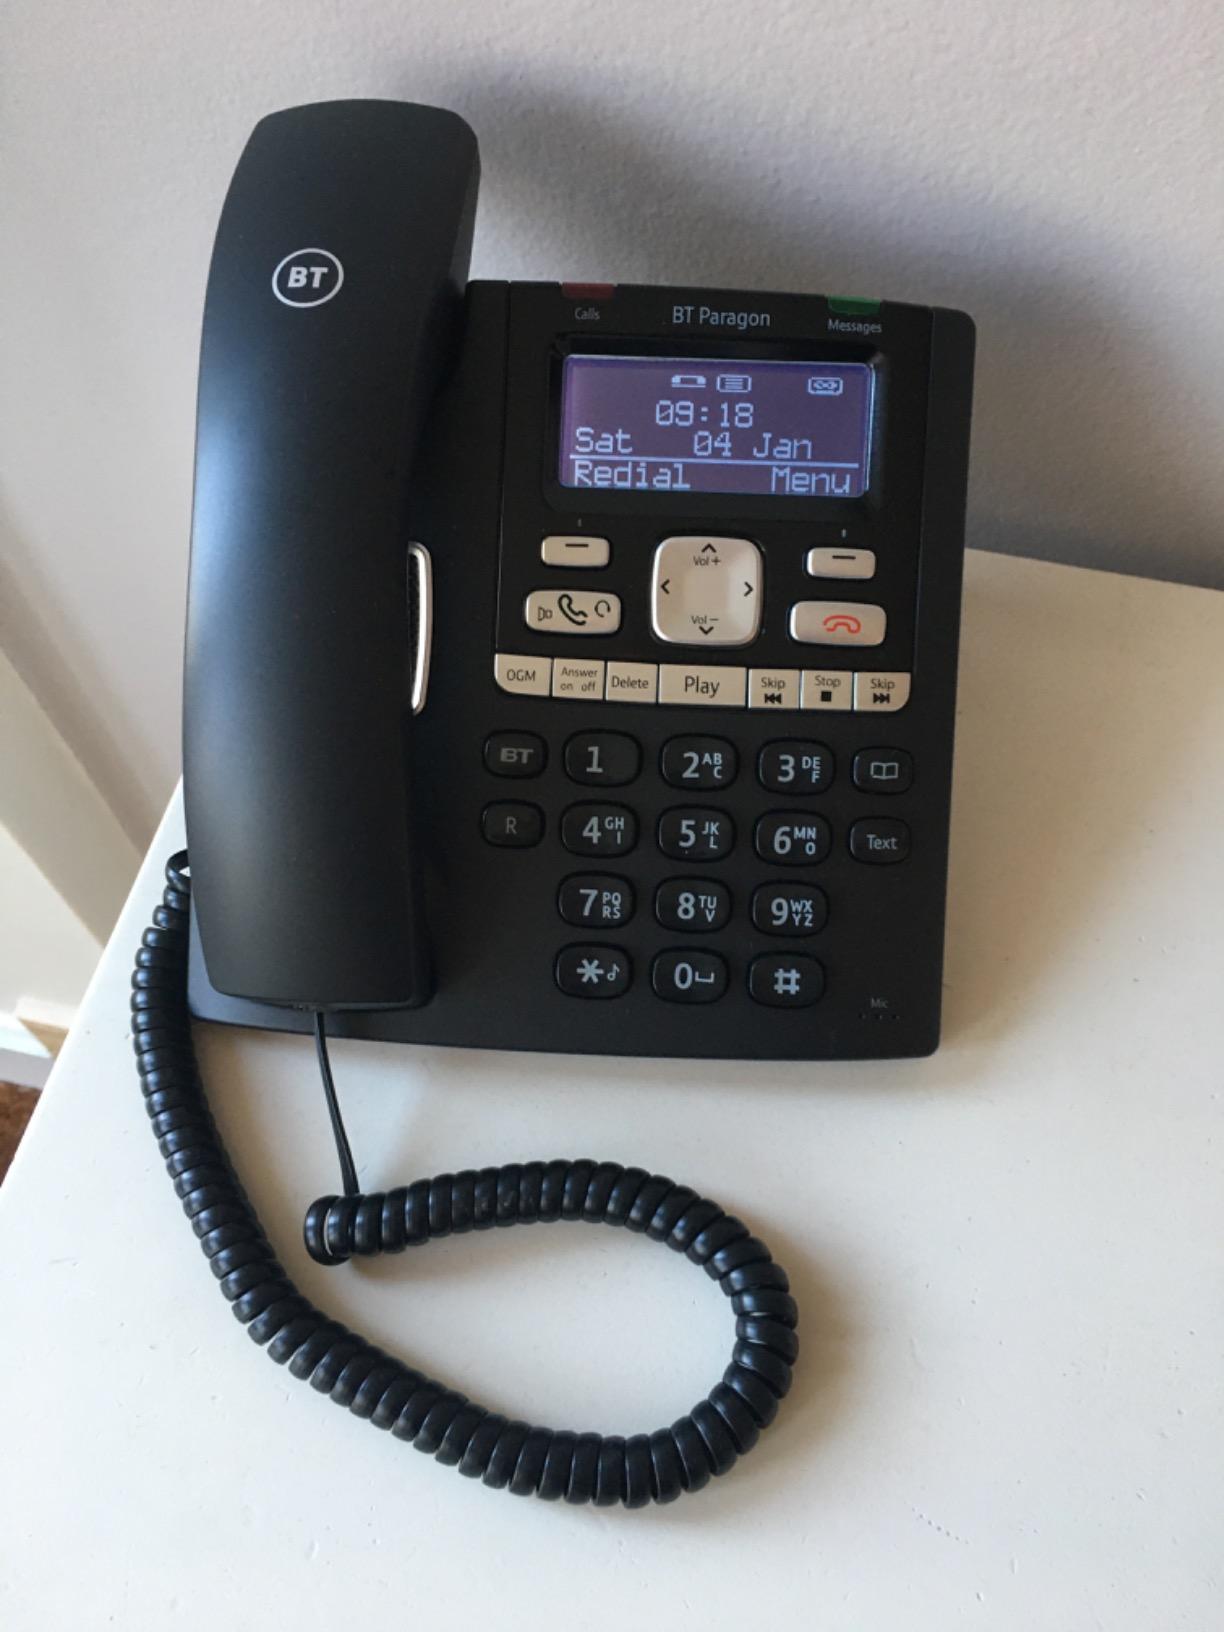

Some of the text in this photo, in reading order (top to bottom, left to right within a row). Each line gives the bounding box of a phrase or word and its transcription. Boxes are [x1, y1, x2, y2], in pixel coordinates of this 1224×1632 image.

[288, 266, 328, 288] BT
[574, 308, 600, 321] Calls
[672, 305, 771, 331] BT Paragon
[828, 319, 882, 334] Messages
[655, 400, 754, 428] 09:18
[575, 427, 813, 459] Sat 04 Jan
[574, 461, 690, 489] Redial
[771, 467, 850, 494] Menu
[506, 669, 536, 682] OGM
[561, 666, 598, 679] Answer
[560, 680, 597, 692] on off
[611, 675, 649, 690] Delete
[684, 676, 720, 695] Play
[760, 676, 786, 691] Skip
[814, 674, 841, 689] Stop
[870, 678, 896, 692] Skip
[500, 748, 534, 764] BT
[586, 746, 603, 773] 1
[506, 818, 517, 835] R
[866, 834, 898, 850] Text
[870, 998, 889, 1008] Mic
